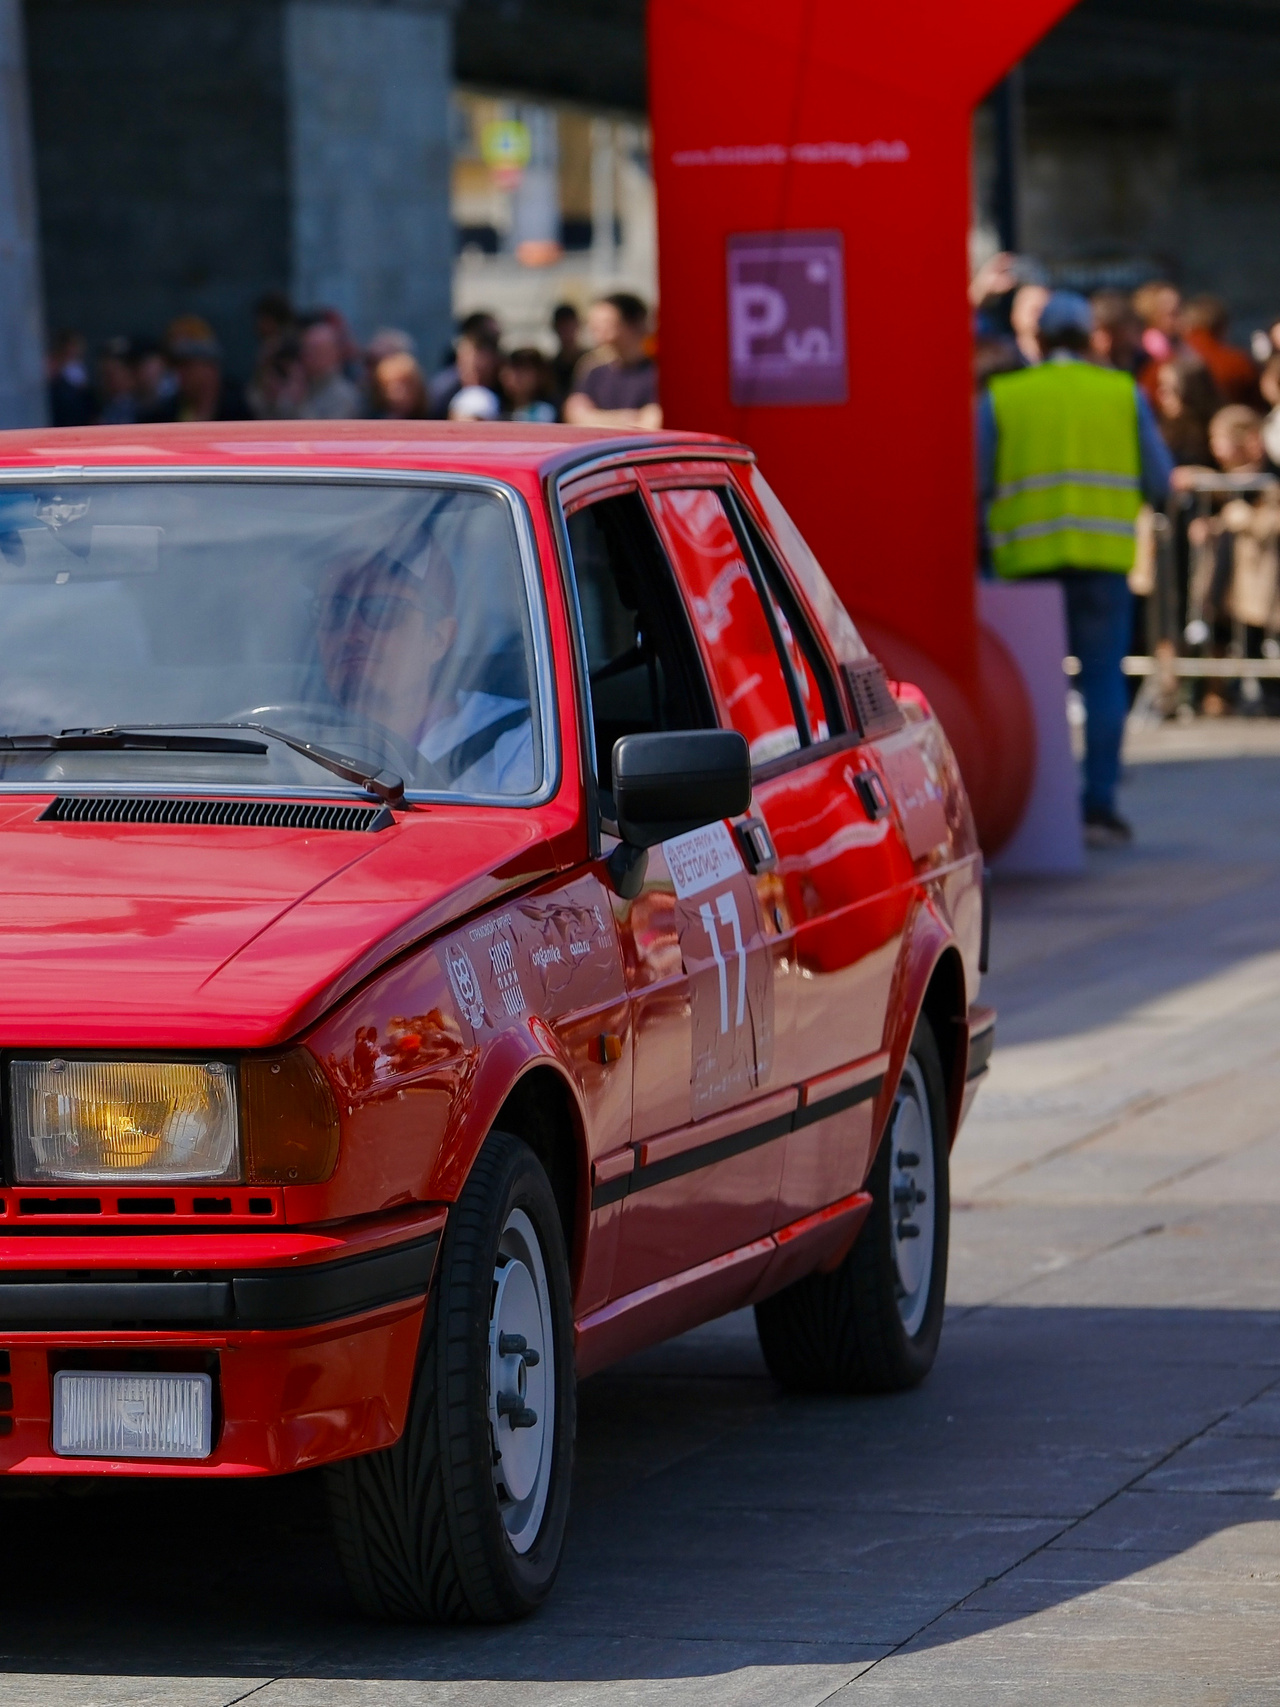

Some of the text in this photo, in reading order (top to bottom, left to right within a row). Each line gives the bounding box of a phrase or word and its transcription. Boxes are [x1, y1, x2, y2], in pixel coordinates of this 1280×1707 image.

[681, 848, 721, 883] СТОЛИЦА
[532, 944, 561, 968] organika
[699, 890, 747, 1035] 17
[497, 969, 519, 990] ПАРИ
